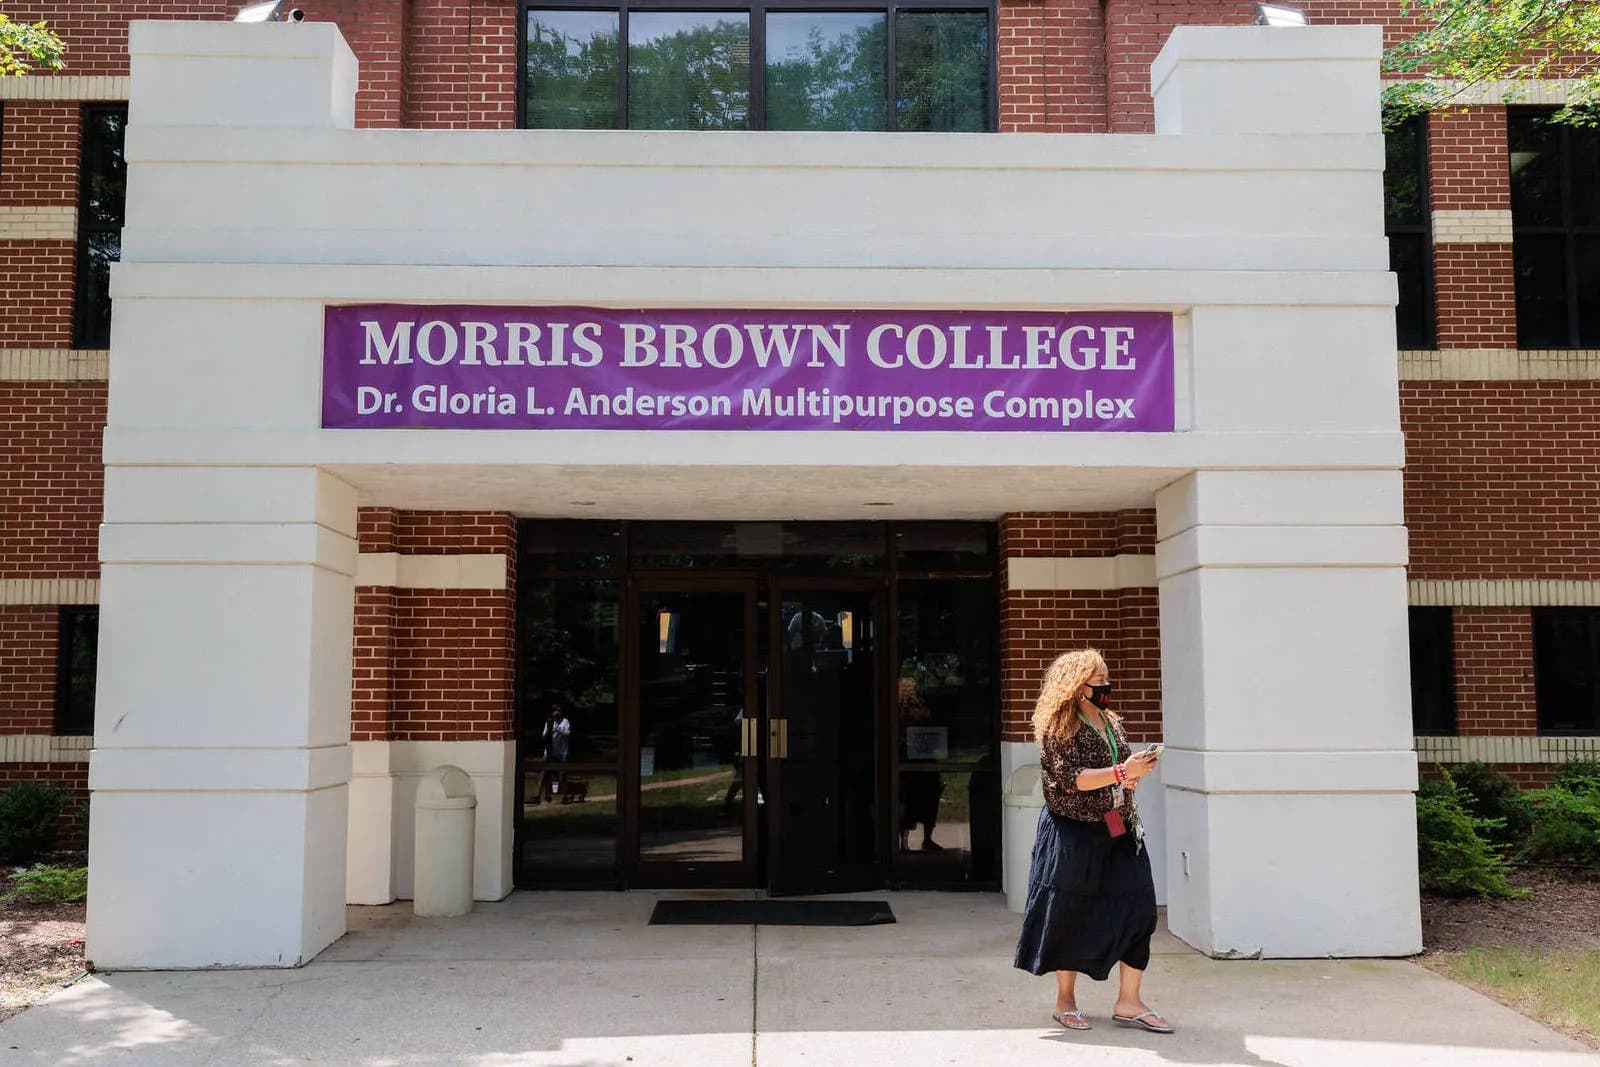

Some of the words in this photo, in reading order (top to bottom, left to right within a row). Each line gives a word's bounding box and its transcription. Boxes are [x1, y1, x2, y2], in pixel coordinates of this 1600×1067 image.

[359, 321, 603, 367] MORRIS
[619, 323, 850, 369] BROWN
[866, 324, 1136, 371] COLLEGE
[357, 386, 403, 415] Dr.
[412, 385, 516, 415] Gloria
[527, 387, 555, 415] L.
[564, 387, 732, 417] Anderson
[742, 387, 975, 425] Multipurpose
[983, 389, 1136, 426] Complex
